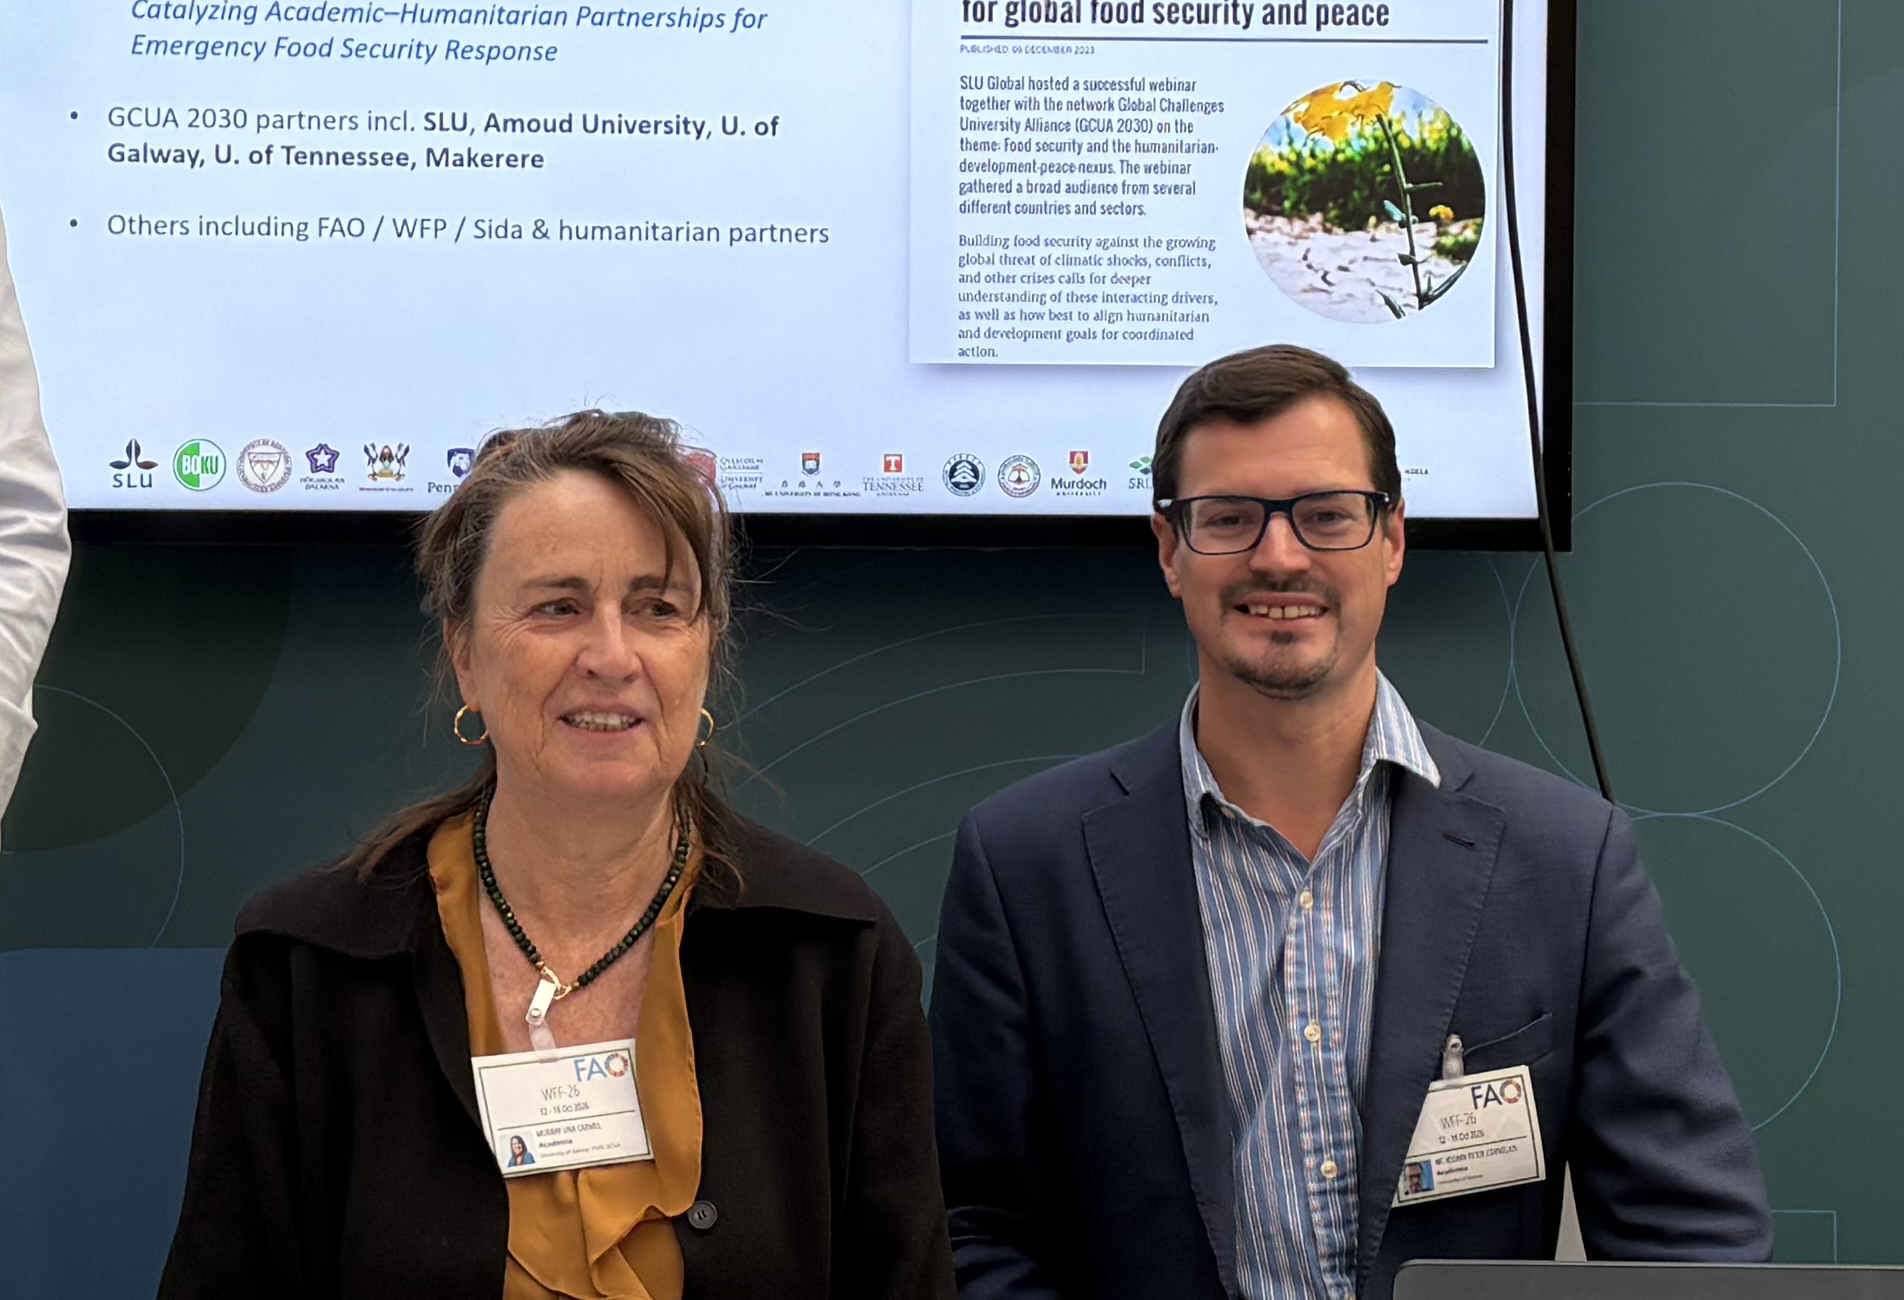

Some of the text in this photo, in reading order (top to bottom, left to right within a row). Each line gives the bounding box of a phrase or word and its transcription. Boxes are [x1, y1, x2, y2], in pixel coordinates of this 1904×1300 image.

[576, 6, 725, 34] Partnerships
[730, 7, 768, 33] for
[1315, 0, 1390, 32] peace
[132, 35, 557, 65] Emergency Food Security Response
[960, 75, 1196, 92] SLU Global hosted a successful webinar
[960, 96, 1224, 115] together with the network Global Challenges
[108, 106, 779, 140] GCUA 2030 partners incl. SLU, Amoud University, U. of
[960, 117, 1193, 135] University Alliance (GCUA 2030) on the
[108, 143, 544, 171] Galway, U. of Tennessee, Makerere
[960, 138, 998, 153] theme:
[1004, 137, 1031, 153] Food
[1036, 138, 1083, 155] security
[1087, 139, 1108, 153] and
[1112, 139, 1131, 154] the
[1120, 160, 1140, 175] The
[1144, 160, 1191, 175] webinar
[108, 214, 828, 248] Others including FAO / WFP / Sida & humanitarian partners
[182, 454, 220, 477] BOKU
[112, 472, 153, 489] SLU
[1050, 477, 1108, 491] Murdoch
[573, 1052, 629, 1083] FAO
[1470, 1079, 1523, 1111] FAO
